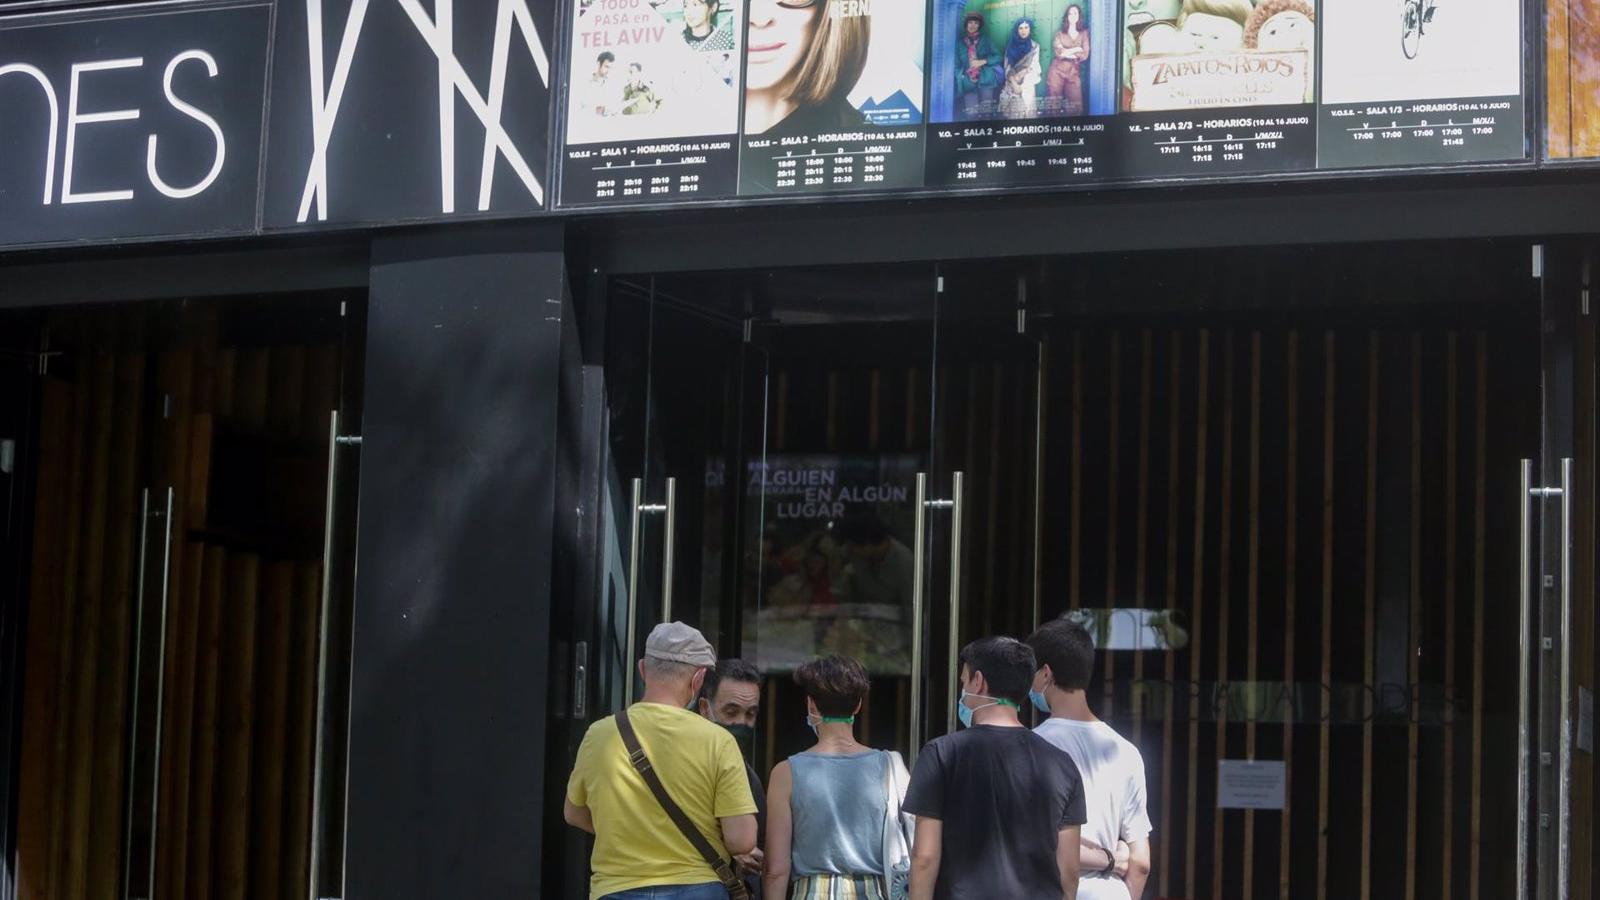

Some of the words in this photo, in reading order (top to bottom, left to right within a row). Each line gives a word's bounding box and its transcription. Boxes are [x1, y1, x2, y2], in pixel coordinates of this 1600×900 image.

[594, 14, 630, 26] PASA
[633, 14, 650, 24] en
[581, 31, 612, 48] TEL
[618, 27, 665, 46] AVIV
[1151, 59, 1233, 85] ZAPATOS
[1366, 107, 1388, 115] SALA
[1388, 106, 1402, 114] 1/3
[1413, 103, 1458, 112] HORARIOS
[1458, 104, 1469, 112] (10
[1488, 102, 1510, 110] JULIO)
[1154, 122, 1176, 131] SALA
[1178, 121, 1192, 130] 2/3
[1203, 118, 1252, 128] HORARIOS
[1253, 119, 1265, 127] (10
[1276, 118, 1285, 126] 16
[1285, 117, 1308, 125] JULIO)
[964, 129, 986, 137] SALA
[987, 128, 993, 136] 2
[1003, 125, 1050, 135] HORARIOS
[1050, 125, 1062, 133] (10
[1353, 132, 1374, 140] 17:00
[1381, 131, 1402, 139] 17:00
[1442, 128, 1462, 136] 17:00
[1472, 127, 1493, 135] 17:00
[781, 137, 802, 146] SALA
[802, 136, 809, 144] 2
[818, 133, 864, 143] HORARIOS
[601, 149, 621, 157] SALA
[637, 144, 680, 154] HORARIOS
[709, 142, 730, 150] JULIO)
[987, 160, 1006, 168] 19:45
[1016, 159, 1036, 167] 19:45
[957, 171, 977, 179] 21:45
[751, 470, 835, 486] ALGUIEN
[805, 487, 832, 502] EN
[837, 482, 907, 502] ALGÚN
[777, 502, 845, 518] LUGAR
